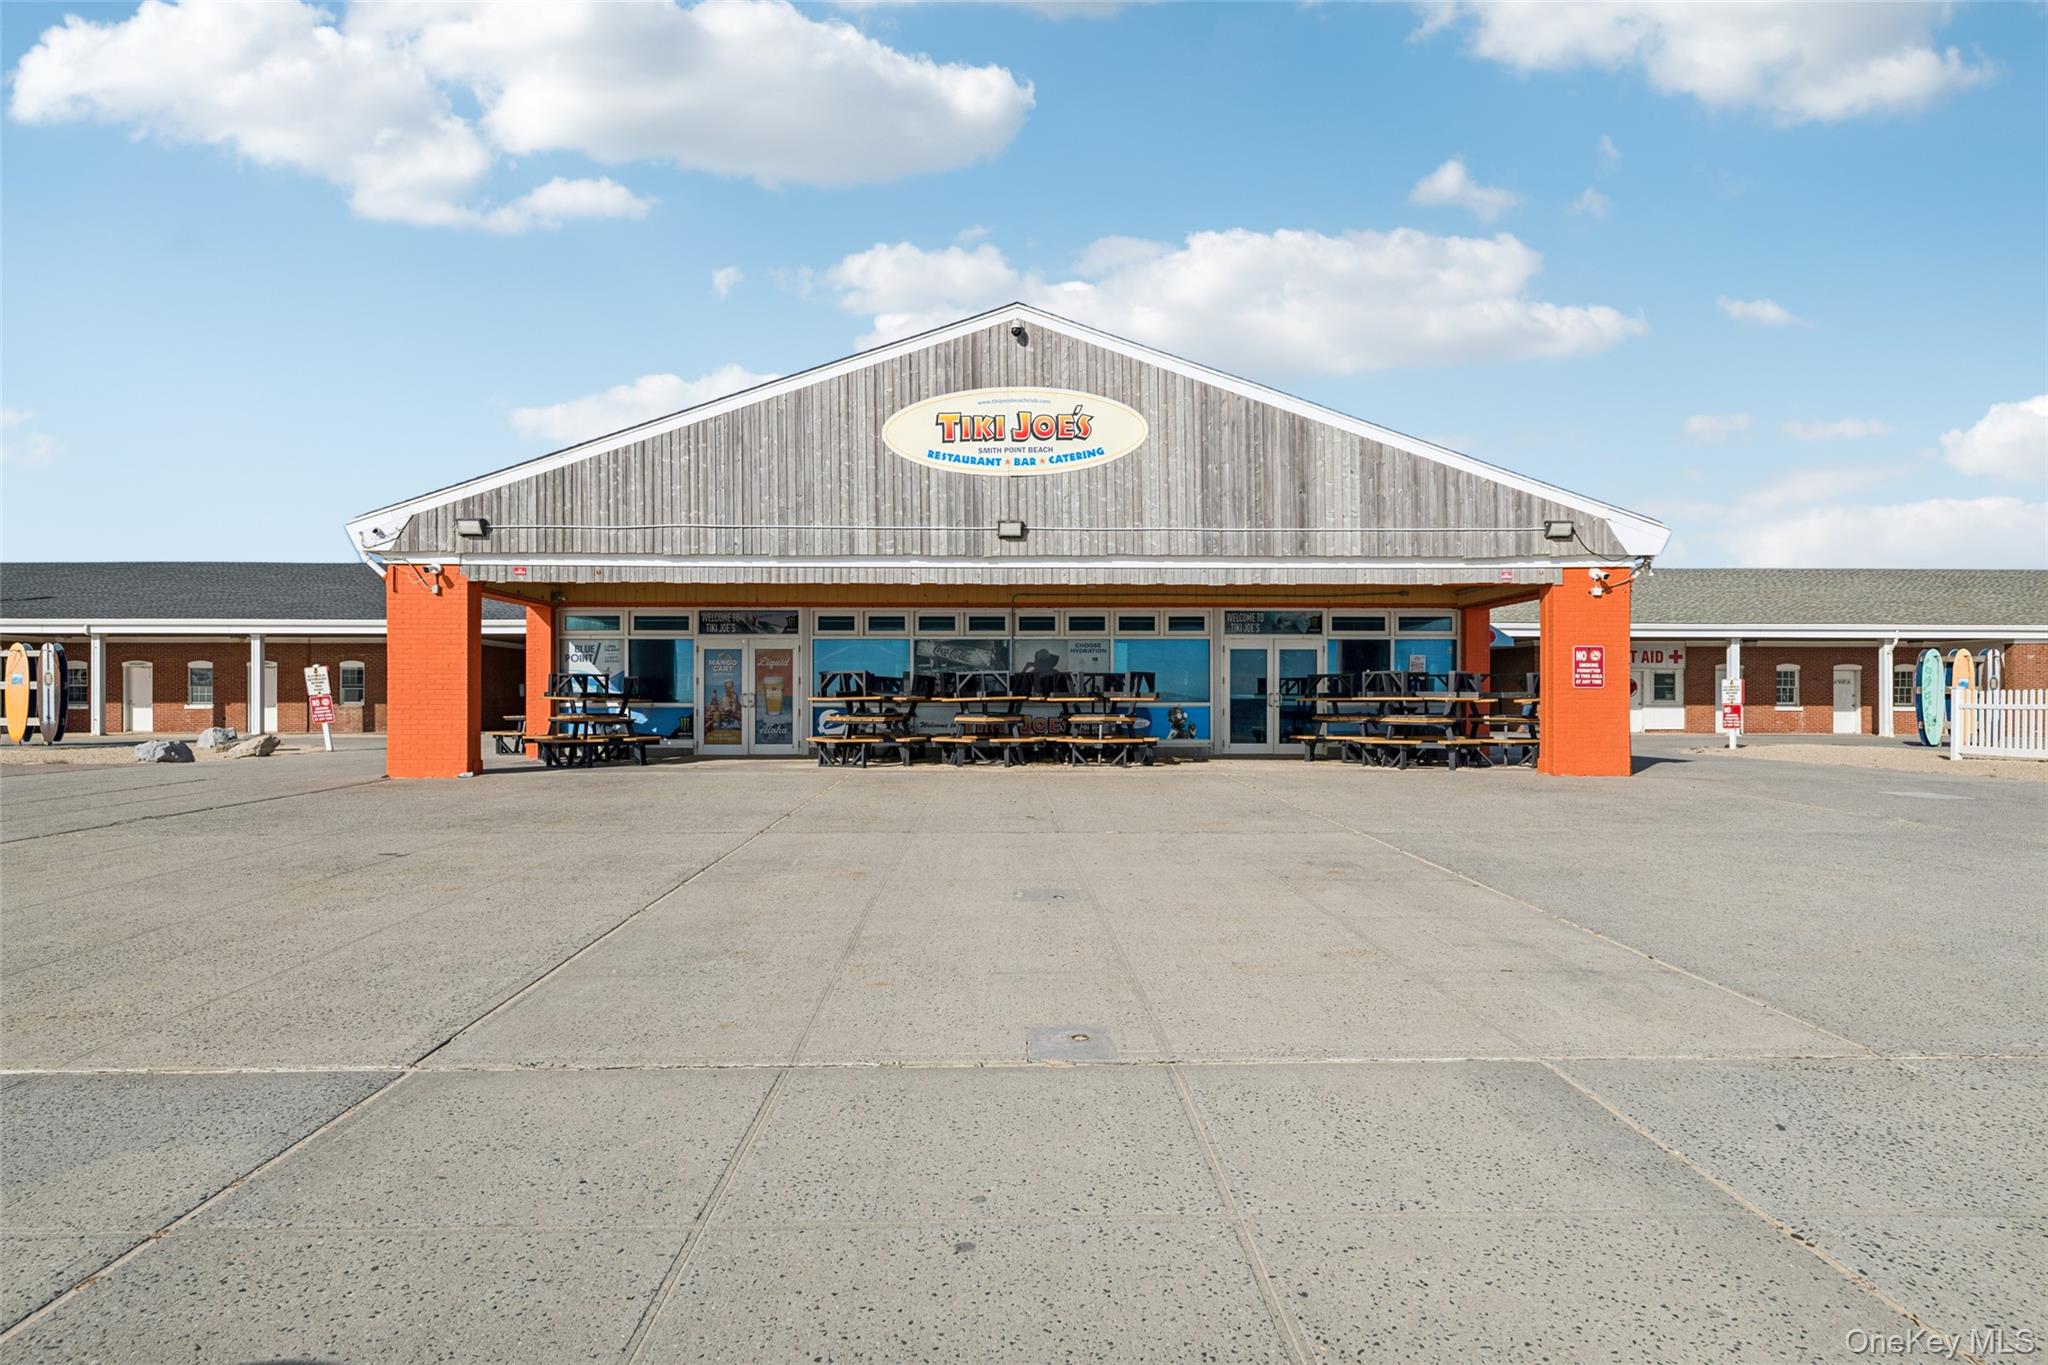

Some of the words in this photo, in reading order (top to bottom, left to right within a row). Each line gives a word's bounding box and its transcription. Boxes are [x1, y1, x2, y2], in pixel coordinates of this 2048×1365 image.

[935, 411, 1005, 443] TIKI
[1010, 404, 1095, 442] JOE'S
[1028, 446, 1054, 454] BEACH
[927, 450, 1002, 467] RESTAURANT
[1014, 457, 1037, 466] BAR
[1048, 447, 1105, 464] CATERING
[701, 611, 732, 622] WELCOME
[1226, 612, 1255, 622] WELCOME
[1256, 612, 1265, 622] TO
[706, 623, 718, 632] TIKI
[719, 623, 736, 632] JOE'S
[1231, 623, 1243, 632] TIKI
[1243, 623, 1261, 632] JOE'S
[575, 644, 596, 653] BLUE
[565, 653, 594, 663] POINT
[1576, 650, 1587, 661] NO
[1641, 650, 1664, 663] AID
[759, 723, 788, 736] Aloha
[920, 721, 950, 729] Welcome
